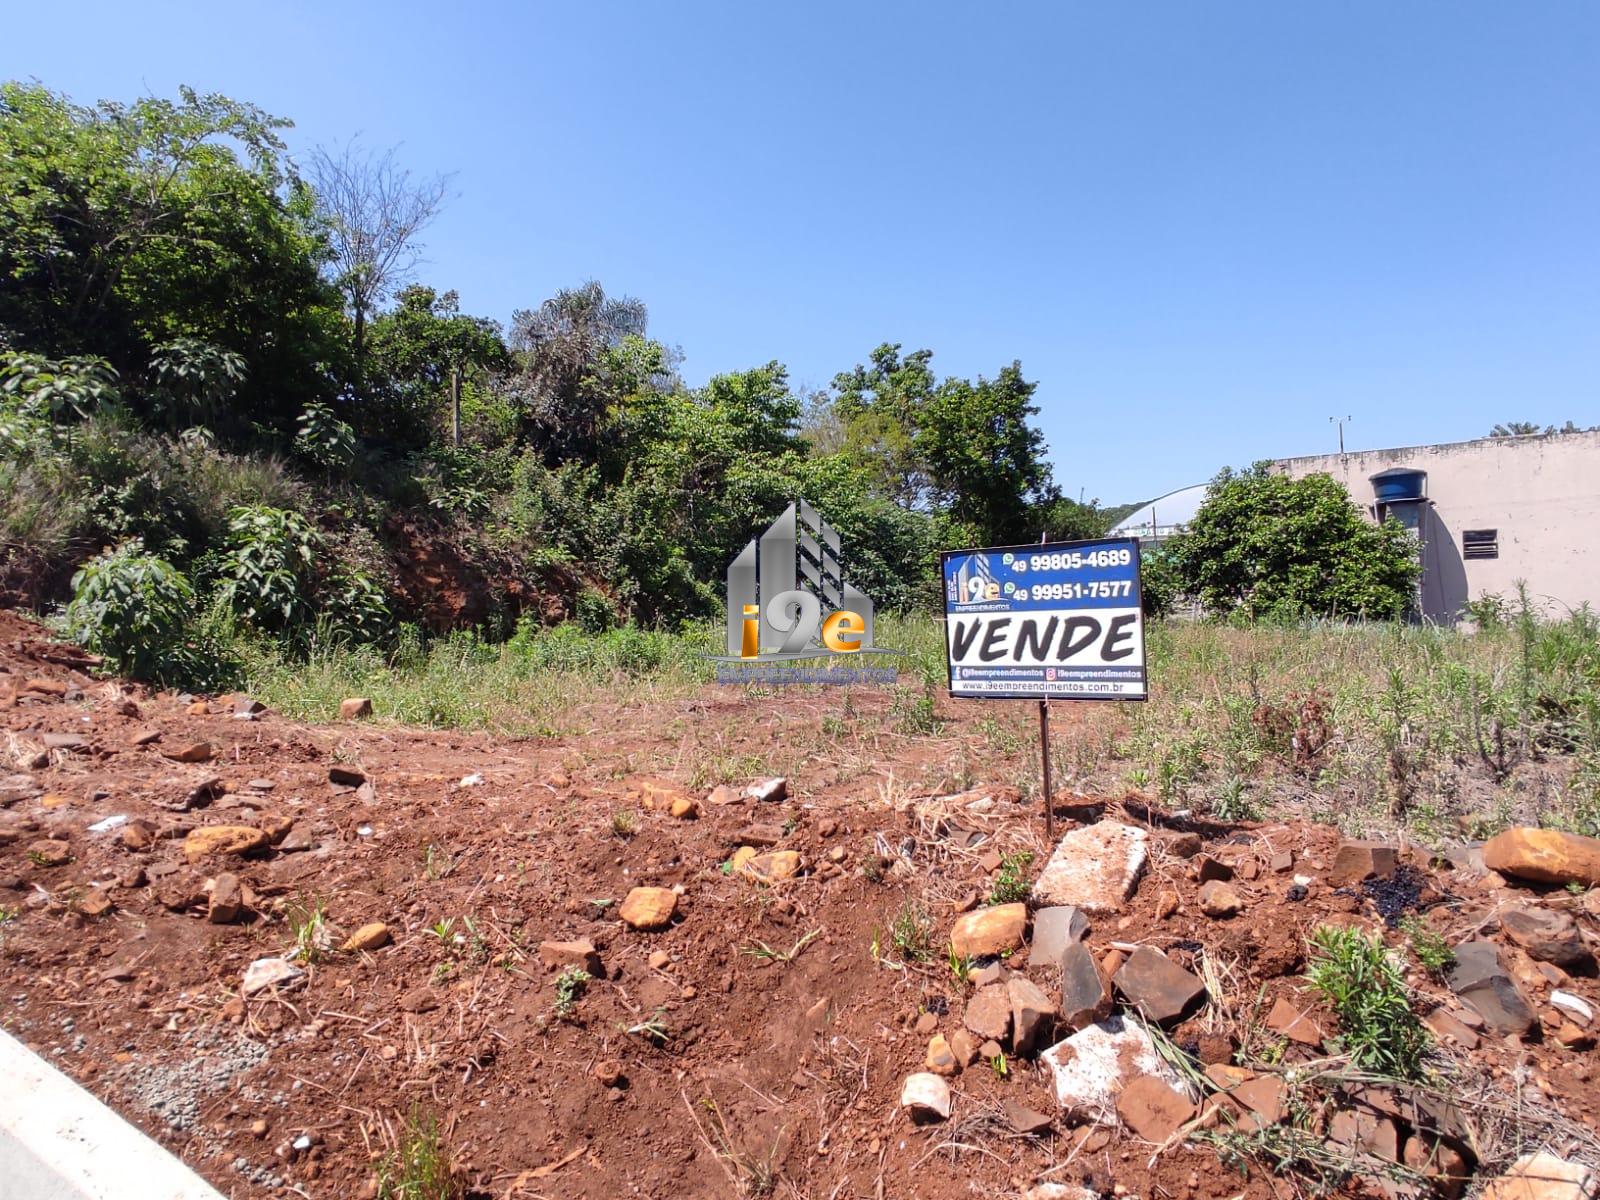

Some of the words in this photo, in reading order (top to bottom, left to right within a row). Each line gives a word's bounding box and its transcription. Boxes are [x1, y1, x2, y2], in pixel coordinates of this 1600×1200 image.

[1011, 560, 1027, 572] 49
[1030, 549, 1131, 571] 99805-4689
[1013, 589, 1029, 600] 49
[1031, 580, 1131, 600] 99951-7577
[952, 613, 1137, 662] VENDE
[962, 681, 1124, 692] www.i9eempreendimentos.com.br
